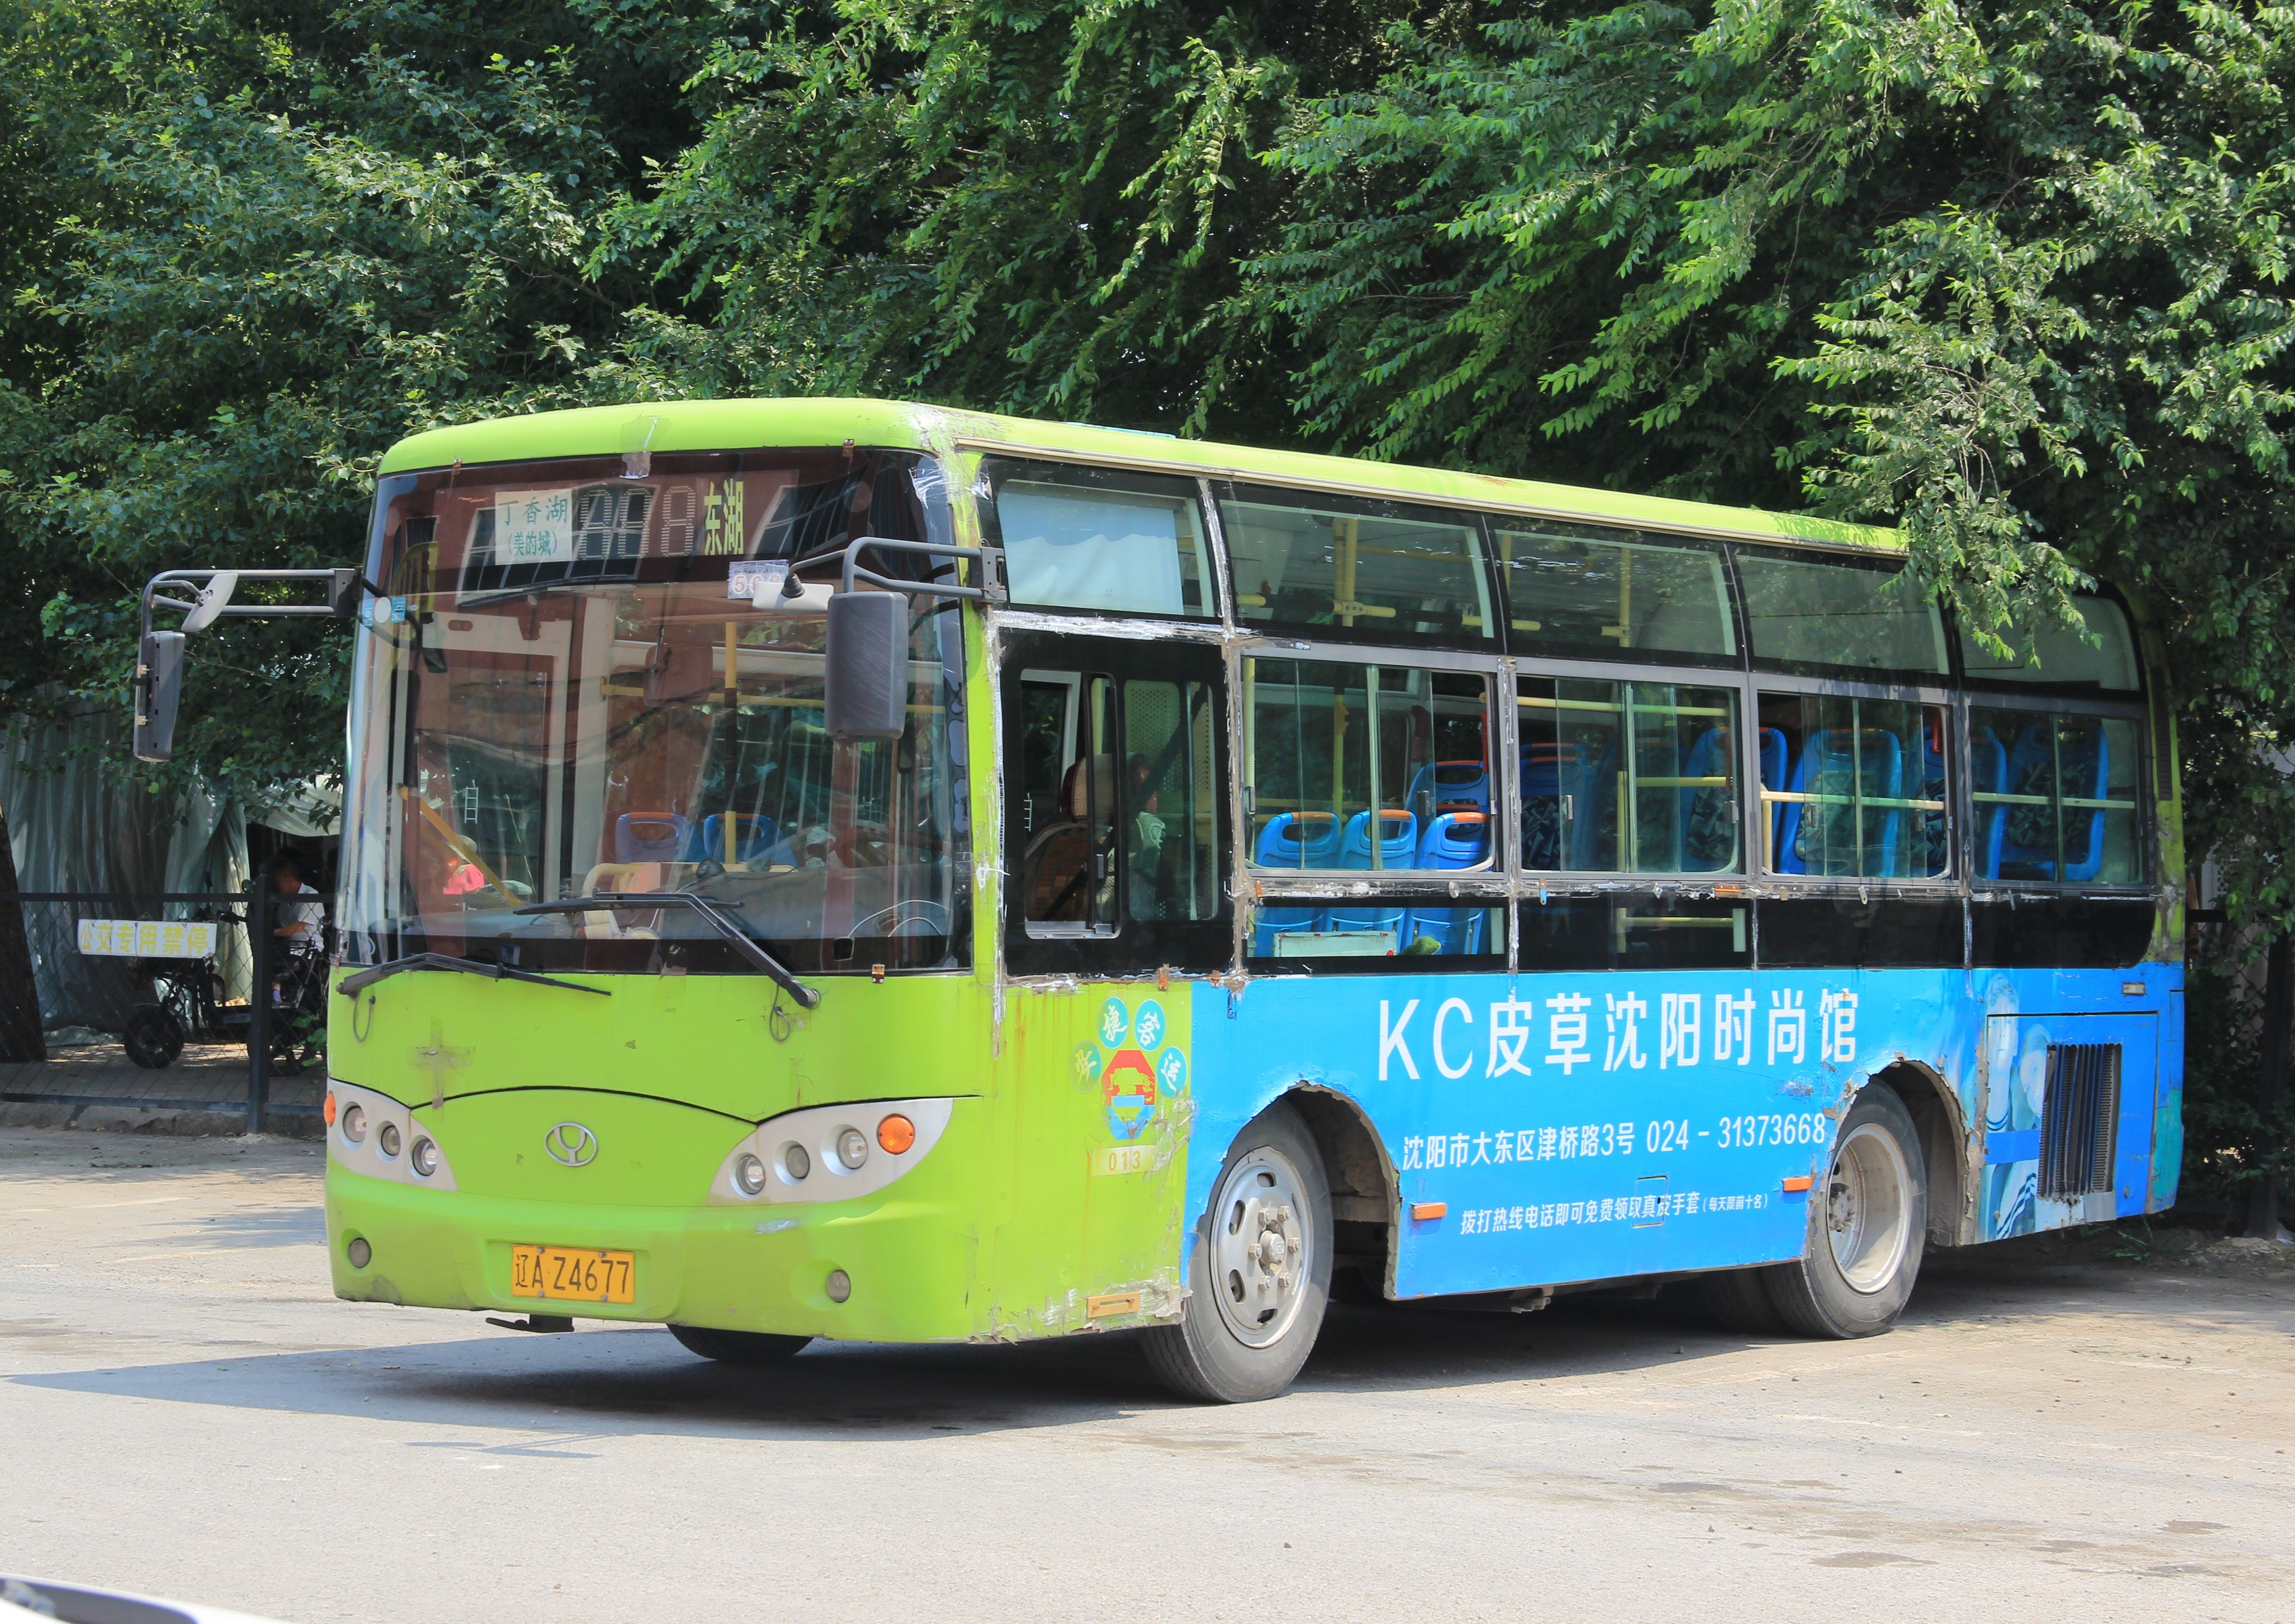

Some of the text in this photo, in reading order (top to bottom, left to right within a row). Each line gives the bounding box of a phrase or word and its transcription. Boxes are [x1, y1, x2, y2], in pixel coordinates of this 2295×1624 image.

[499, 495, 568, 526] 丁香湖
[704, 478, 744, 555] 东湖
[80, 923, 209, 956] 公交专用禁停
[1401, 1122, 1635, 1170] 沈阳市大东区津桥路3号
[1646, 1120, 1689, 1153] 024
[1717, 1113, 1825, 1148] 31373668
[1109, 1150, 1141, 1171] 013
